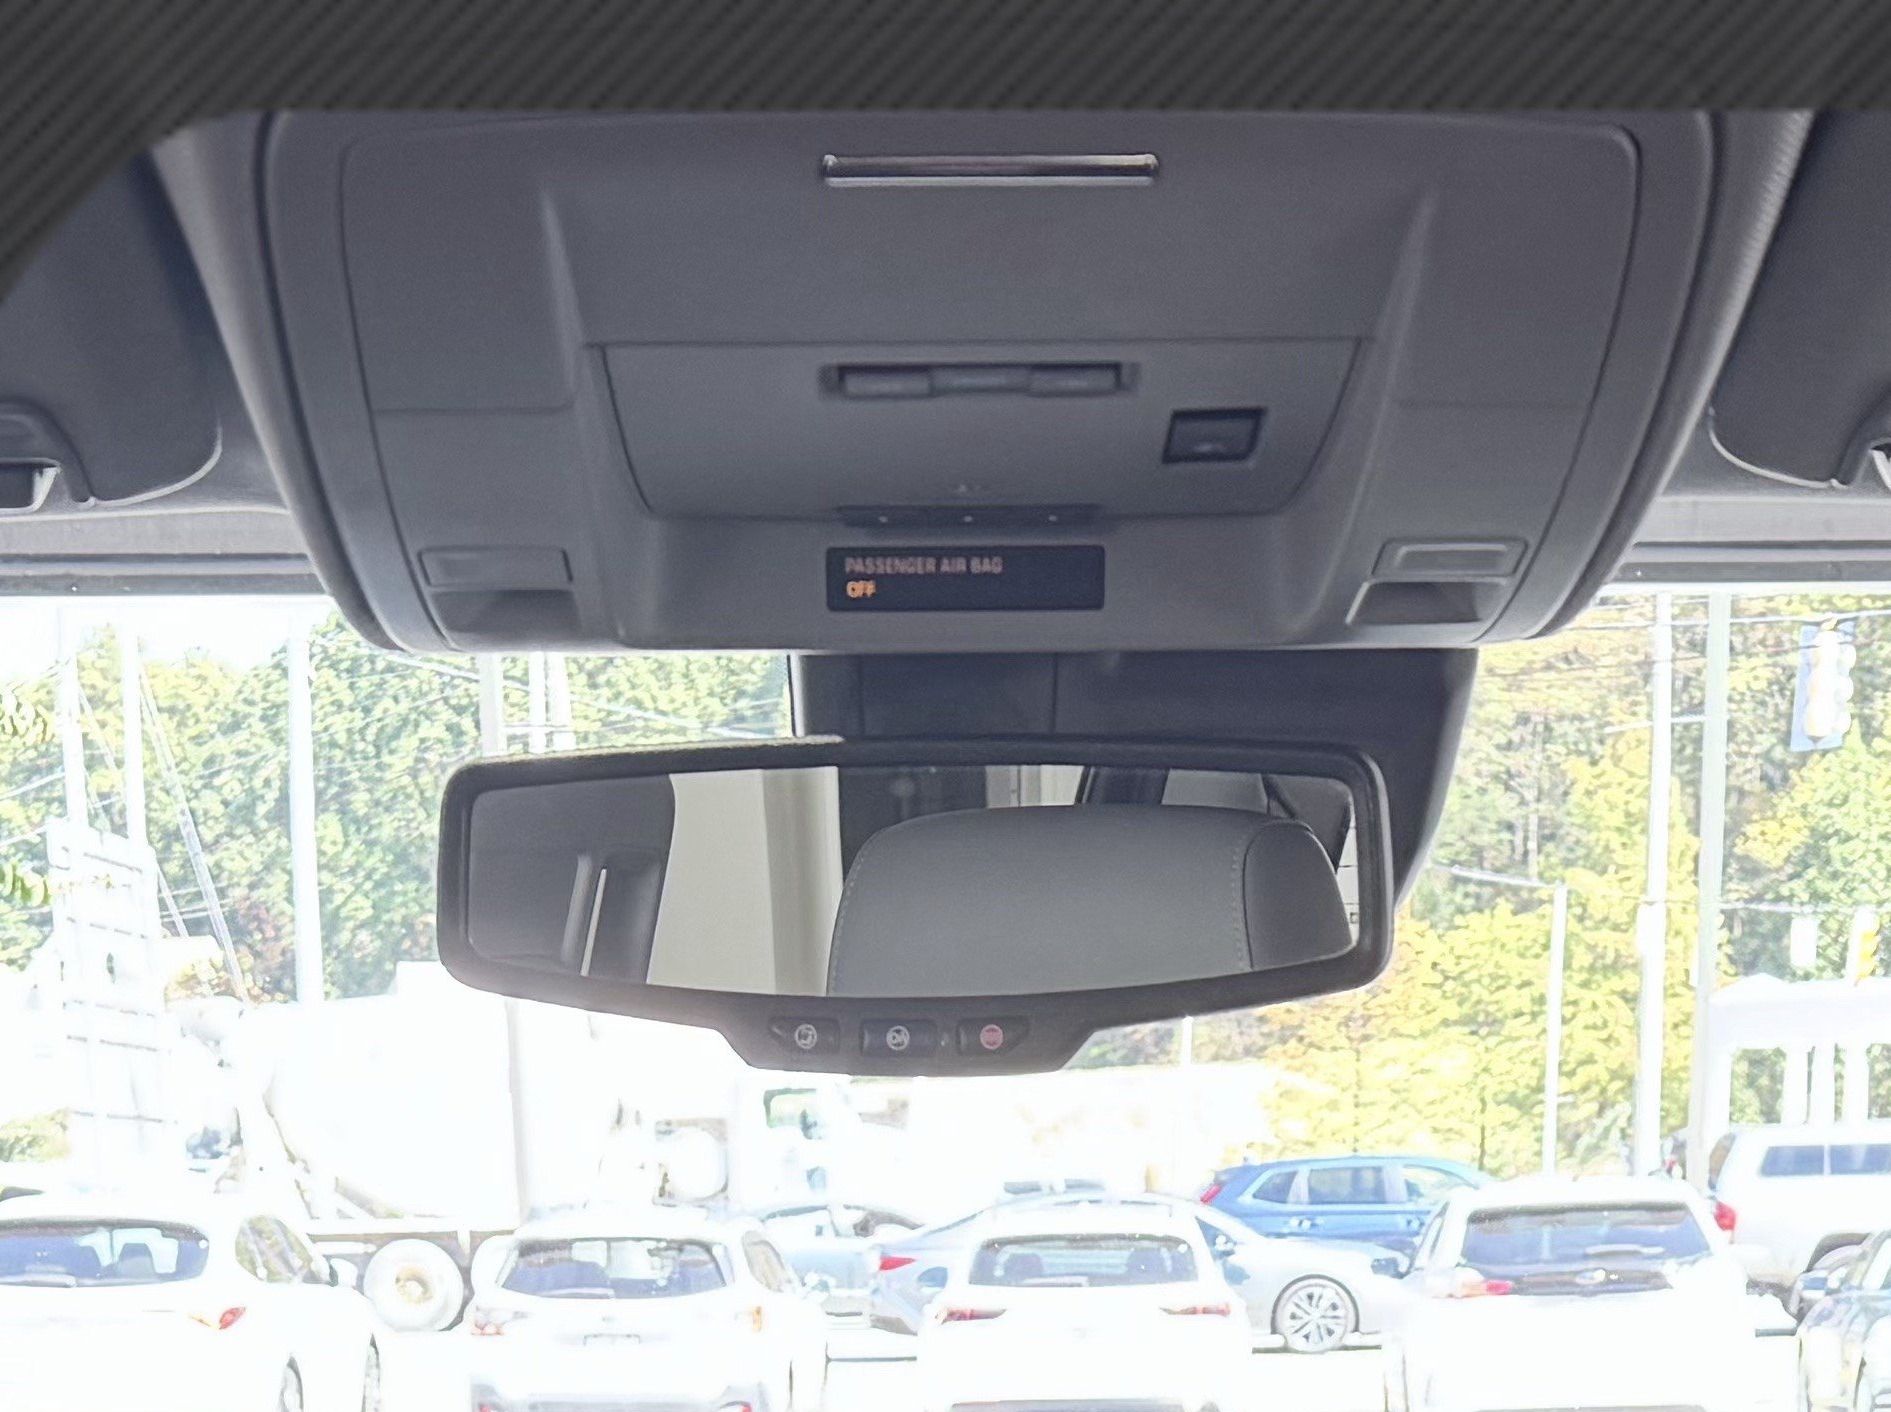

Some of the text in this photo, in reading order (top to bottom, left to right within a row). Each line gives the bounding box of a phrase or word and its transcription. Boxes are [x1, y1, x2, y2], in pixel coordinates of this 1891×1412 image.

[845, 556, 1003, 575] PASSENGER AIR BAG
[846, 580, 876, 598] OFF
